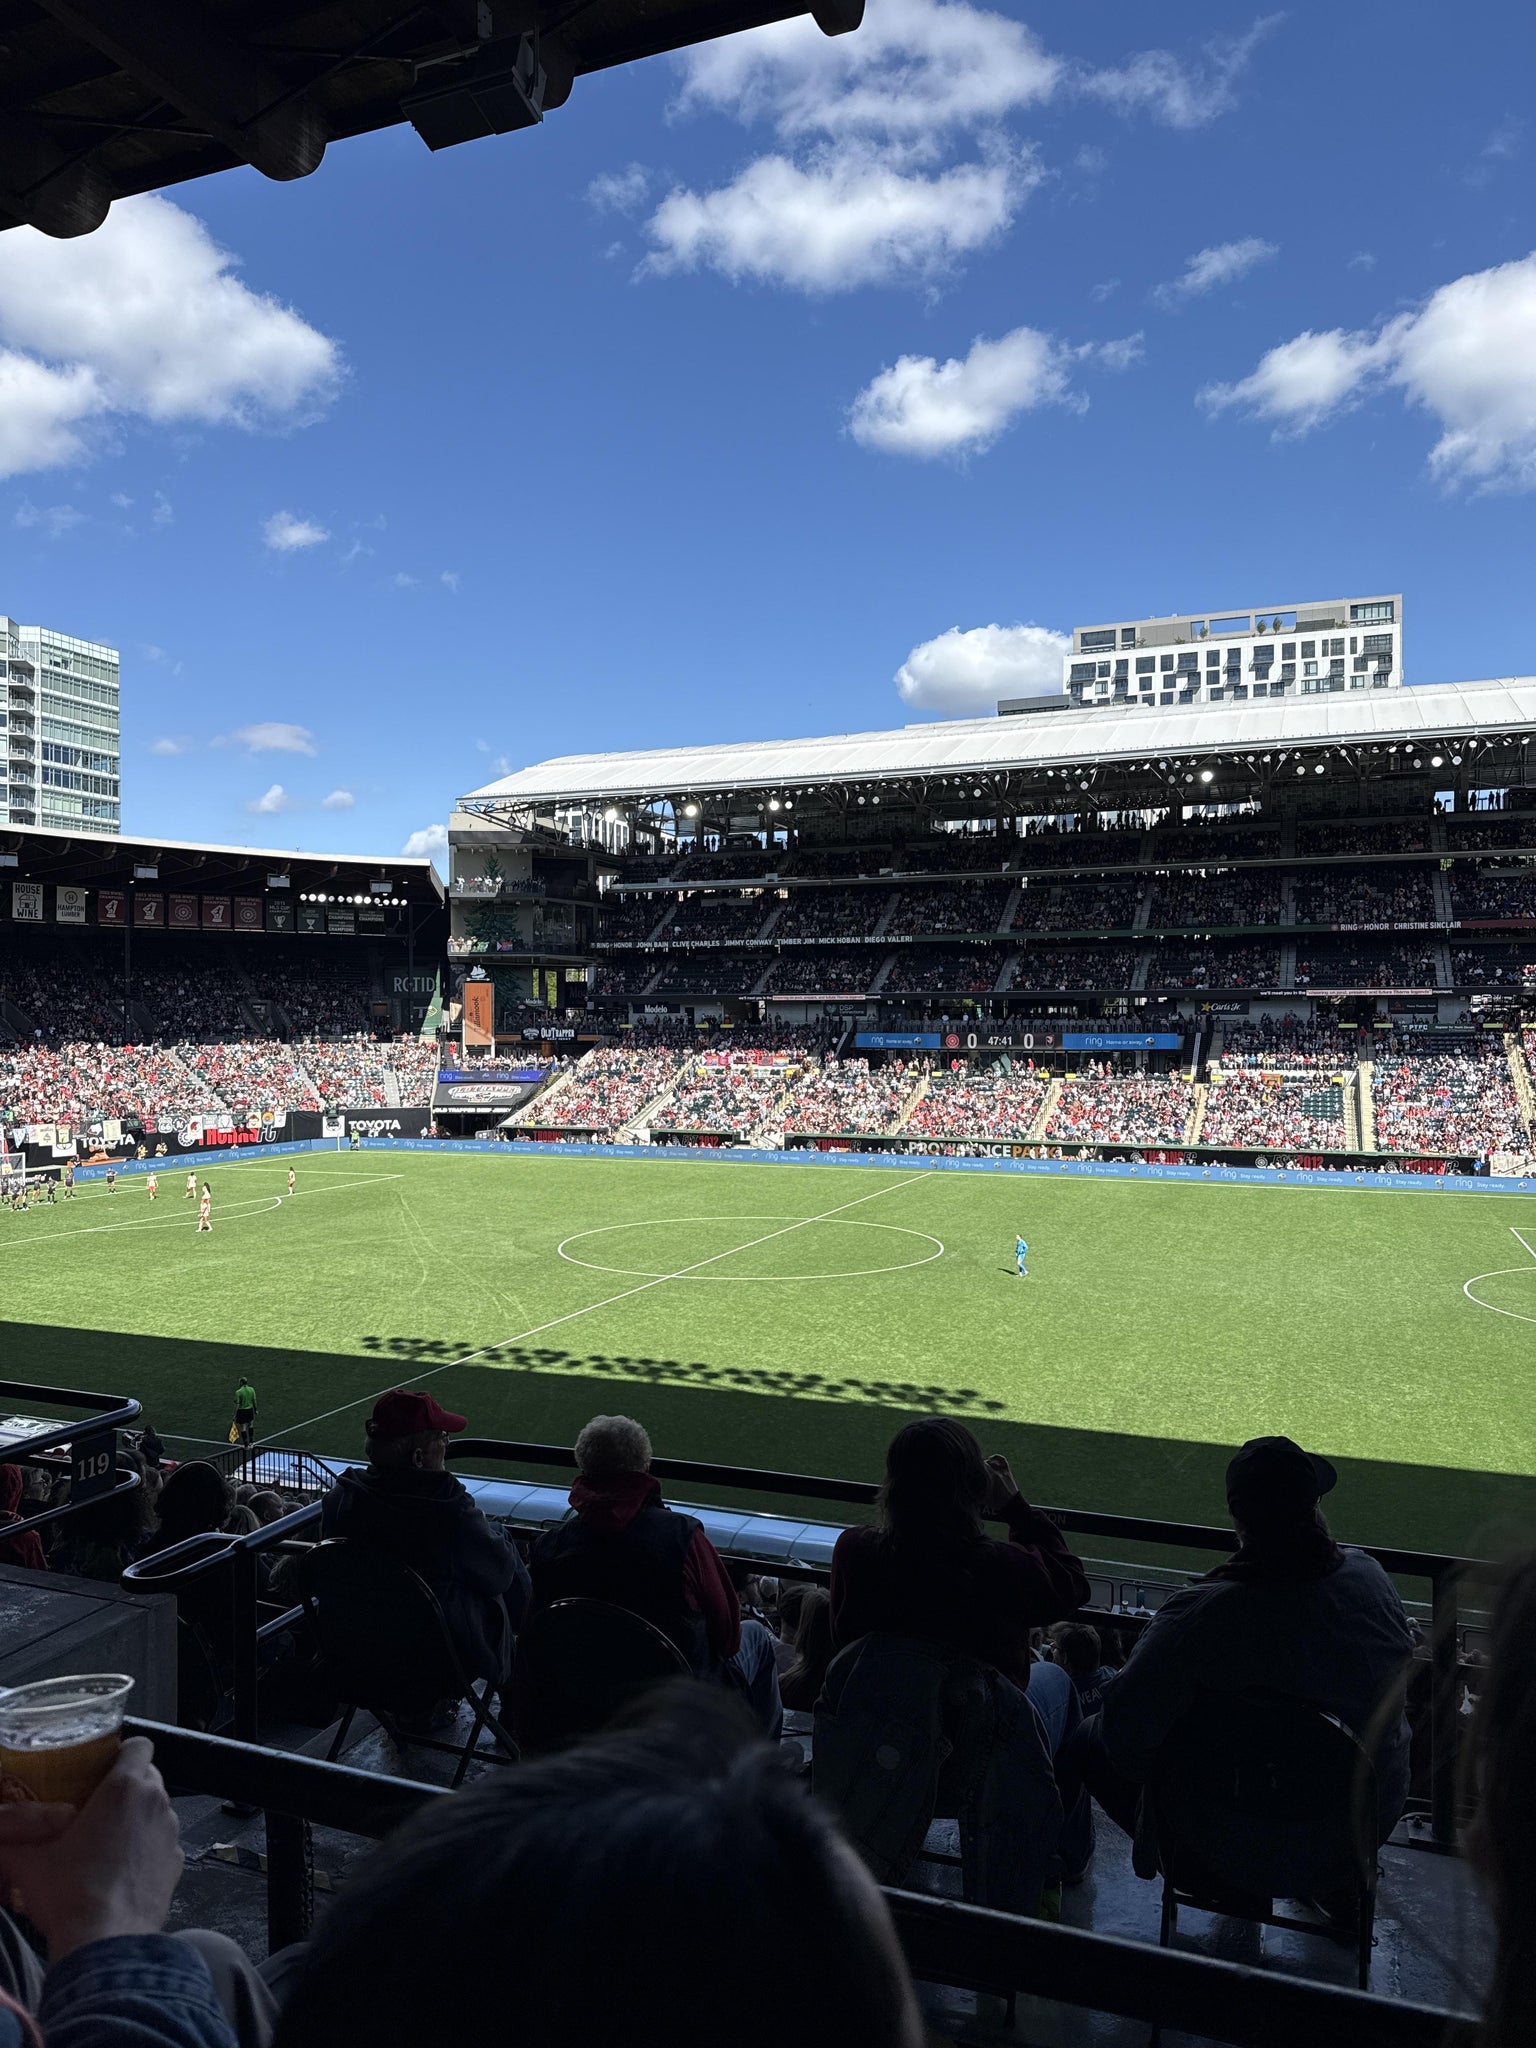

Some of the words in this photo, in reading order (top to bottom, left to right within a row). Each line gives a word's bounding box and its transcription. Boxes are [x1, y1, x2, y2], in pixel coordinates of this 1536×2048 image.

[15, 884, 40, 894] HOUSE
[57, 904, 84, 912] HAMPTON
[17, 909, 38, 918] WINE
[1394, 922, 1429, 930] CHRISTINE
[1429, 921, 1461, 929] SINCLAIR
[746, 938, 772, 946] CONWAY
[837, 936, 860, 944] HOBAN
[887, 935, 913, 943] VALERI
[644, 1004, 668, 1013] Modelo
[871, 1036, 883, 1045] ring
[967, 1033, 978, 1049] 0
[988, 1036, 1012, 1046] 47:41
[1023, 1033, 1034, 1049] 0
[1085, 1037, 1103, 1047] ring
[348, 1120, 401, 1130] TOYOTA
[883, 1156, 897, 1165] ring
[945, 1158, 960, 1168] ring
[1010, 1160, 1024, 1170] ring
[1295, 1155, 1324, 1169] 2012
[1077, 1164, 1093, 1174] ring
[1147, 1167, 1163, 1177] ring
[1220, 1169, 1237, 1179] ring
[1296, 1172, 1313, 1183] ring
[1374, 1175, 1392, 1186] ring
[1455, 1178, 1473, 1189] ring
[78, 1452, 110, 1481] 119
